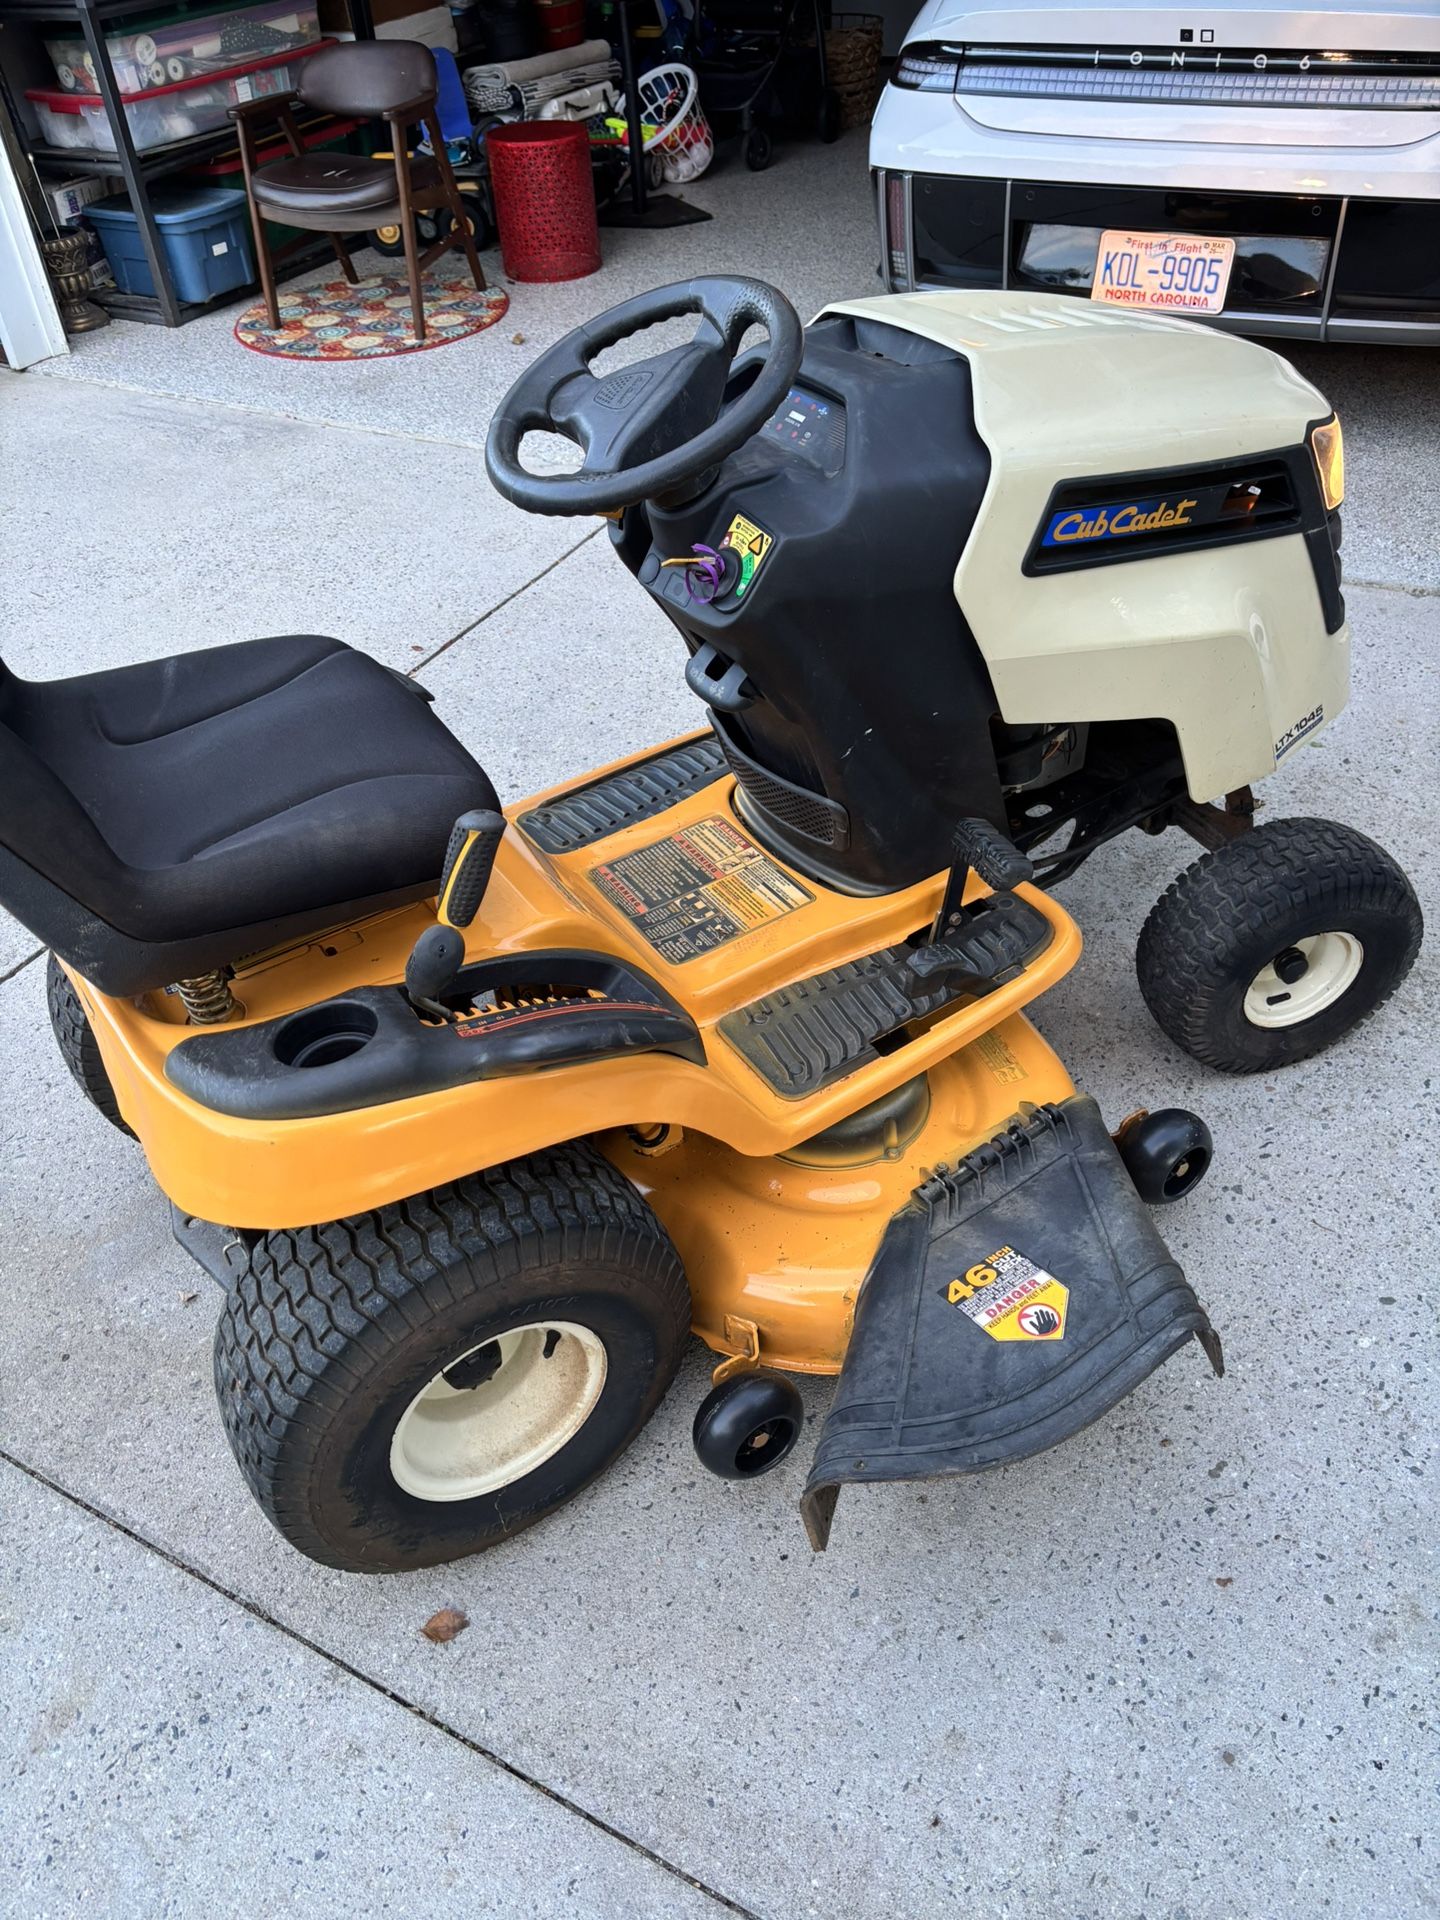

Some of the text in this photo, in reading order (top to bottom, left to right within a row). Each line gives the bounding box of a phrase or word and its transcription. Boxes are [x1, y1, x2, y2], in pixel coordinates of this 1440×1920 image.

[1093, 49, 1311, 71] IONIQ 6
[1131, 239, 1153, 251] First
[1174, 242, 1202, 255] Flight
[1105, 289, 1209, 308] NORTH CAROLINA
[1052, 499, 1197, 542] Cub Cadet
[1275, 728, 1294, 752] LTX
[1294, 704, 1324, 733] 1045
[685, 843, 718, 873] WARNING
[610, 877, 641, 908] WARNING
[985, 1246, 1012, 1264] INCH
[992, 1250, 1018, 1269] CUT
[998, 1254, 1025, 1273] DECK
[947, 1263, 998, 1304] 46
[985, 1279, 1040, 1318] DANGER
